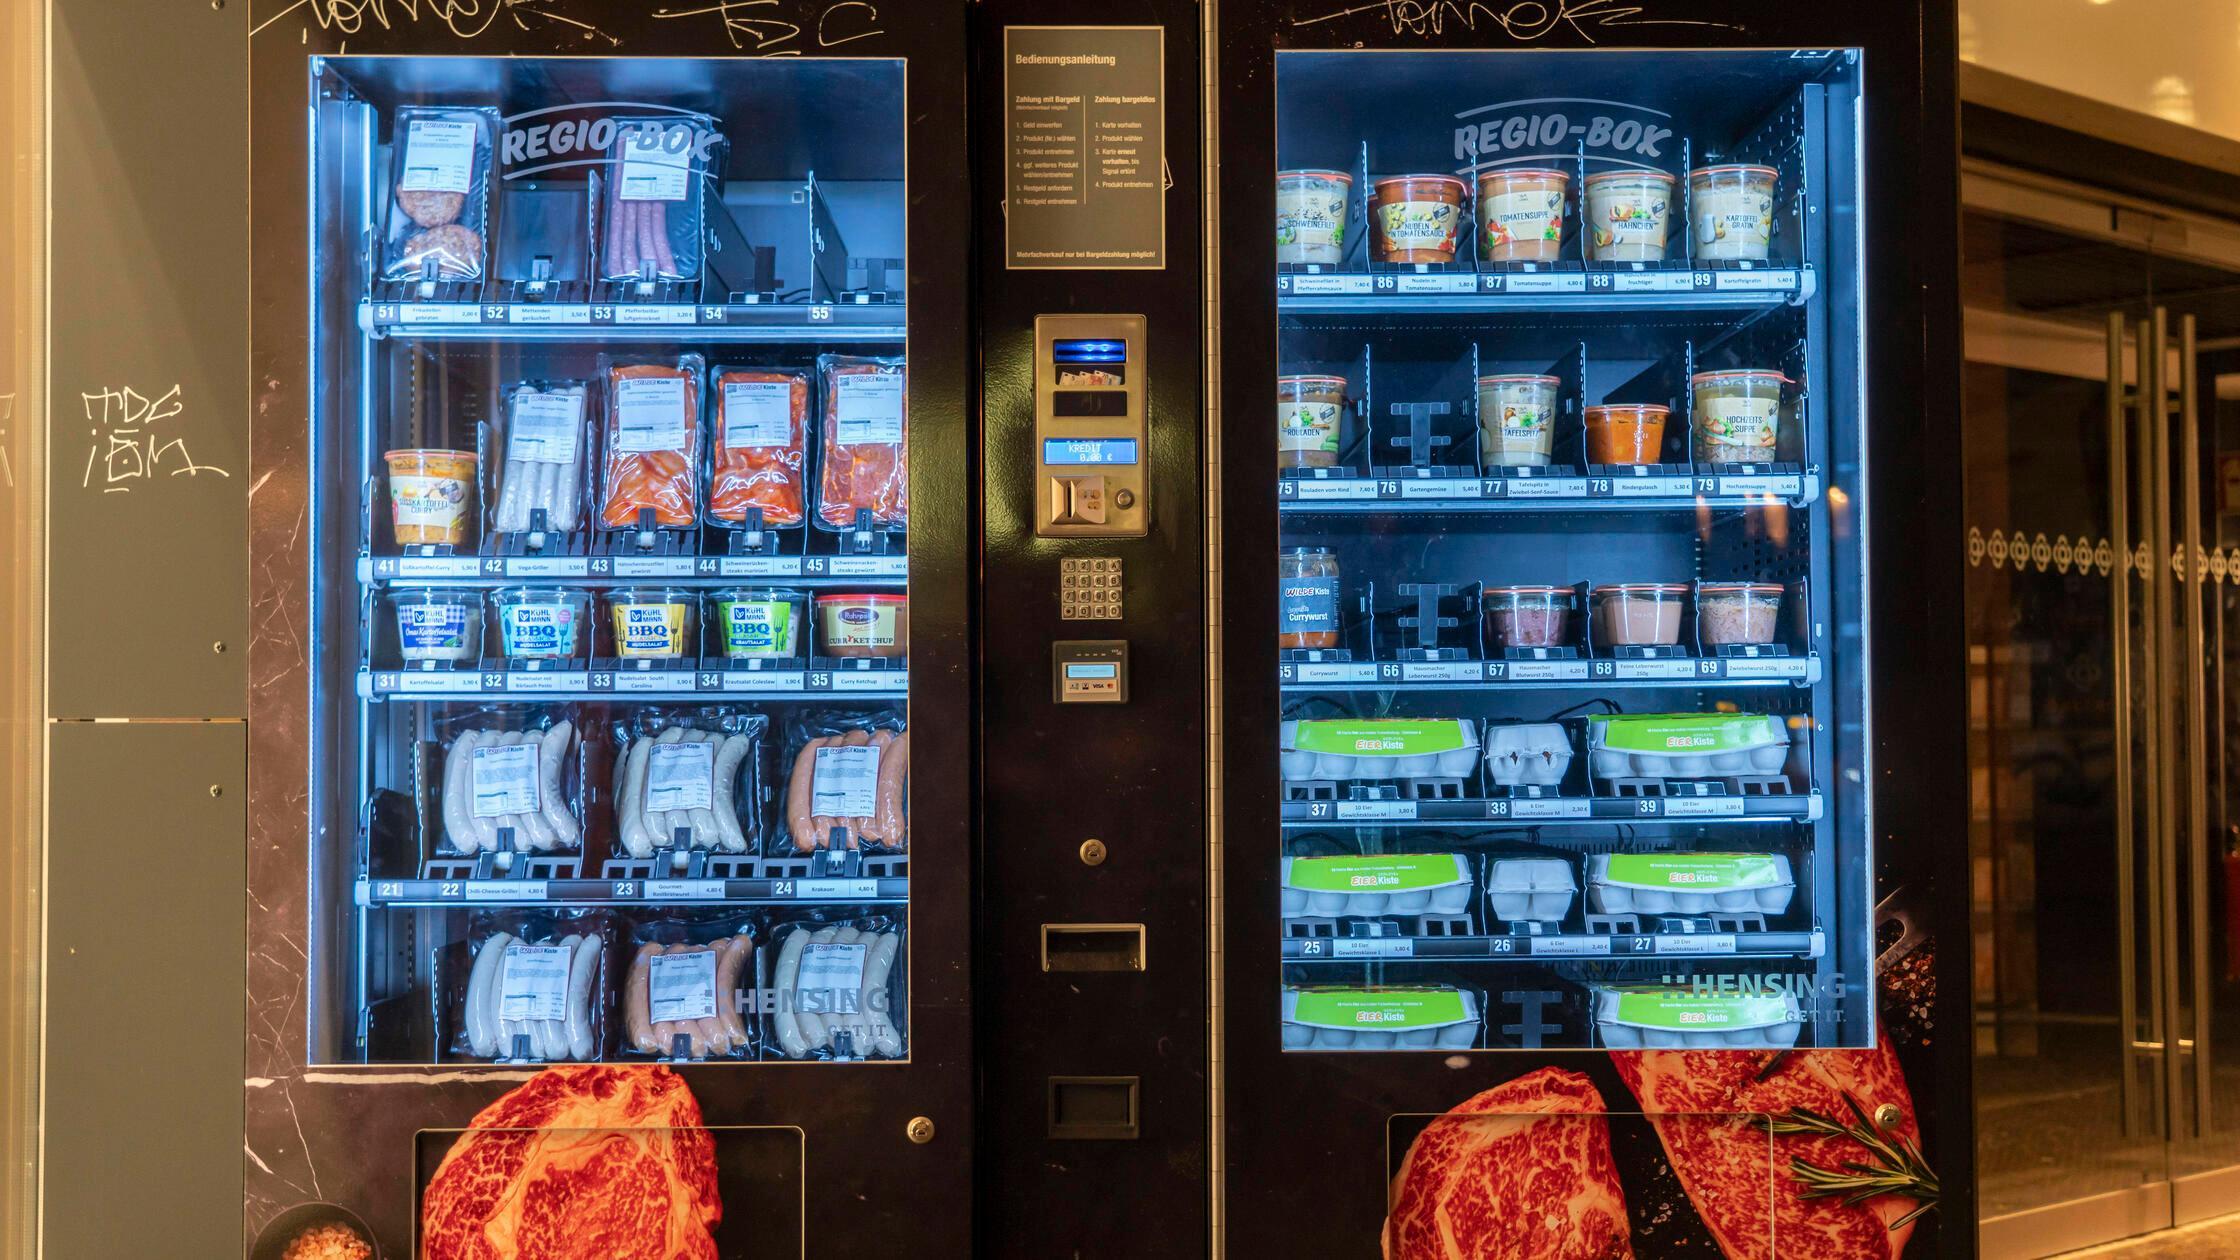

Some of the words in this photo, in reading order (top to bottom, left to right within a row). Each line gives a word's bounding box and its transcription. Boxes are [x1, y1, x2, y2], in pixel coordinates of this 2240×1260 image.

[1016, 54, 1116, 66] Bedienungsanleitung
[1016, 96, 1042, 104] Zahlung
[1055, 96, 1080, 104] Bargeld
[1094, 96, 1120, 104] Zahlung
[1122, 96, 1156, 104] bargeldlos
[502, 118, 723, 165] REGIO-BOX
[1454, 114, 1672, 160] REGIO-BOX
[1500, 211, 1549, 222] TOMATENSUPPE
[1377, 276, 1394, 289] 86
[1486, 276, 1502, 288] 87
[1592, 275, 1608, 287] 88
[1694, 273, 1710, 286] 89
[379, 306, 394, 318] 51
[487, 306, 504, 318] 52
[595, 307, 612, 318] 53
[706, 308, 722, 320] 54
[812, 308, 828, 319] 55
[1288, 428, 1320, 436] ROULADEN
[1068, 444, 1100, 453] KREDIT
[1380, 482, 1396, 494] 76
[1486, 481, 1502, 493] 77
[1592, 480, 1608, 492] 78
[1698, 479, 1714, 491] 79
[379, 560, 395, 572] 41
[486, 560, 502, 572] 42
[592, 560, 608, 572] 43
[700, 560, 716, 571] 44
[807, 559, 824, 571] 45
[1285, 587, 1315, 598] WILDE
[1289, 613, 1328, 622] Currywurst
[515, 626, 556, 638] BBQ
[628, 625, 668, 637] BBQ
[732, 623, 770, 635] BBQ
[829, 635, 853, 644] CURRY
[1383, 664, 1399, 677] 66
[1489, 664, 1504, 676] 67
[1596, 662, 1612, 674] 68
[1701, 661, 1717, 674] 69
[380, 674, 395, 687] 31
[485, 674, 502, 686] 32
[594, 674, 610, 686] 33
[702, 674, 718, 686] 34
[812, 674, 828, 686] 35
[1355, 739, 1383, 750] EIER
[1383, 740, 1404, 750] Kiste
[1666, 736, 1693, 748] EIER
[1694, 737, 1714, 745] Kiste
[1311, 804, 1327, 816] 37
[1491, 802, 1507, 814] 38
[1640, 800, 1656, 812] 39
[1351, 875, 1378, 886] EIER
[1378, 875, 1399, 885] Kiste
[1669, 872, 1696, 883] EIER
[1696, 873, 1718, 882] Kiste
[382, 883, 399, 896] 21
[442, 883, 458, 896] 22
[616, 882, 633, 895] 23
[776, 882, 792, 894] 24
[1304, 942, 1320, 954] 25
[1494, 939, 1510, 952] 26
[1635, 938, 1651, 950] 27
[1693, 973, 1846, 998] HENSING
[735, 988, 889, 1013] HENSING
[1356, 1010, 1384, 1022] EIER
[1384, 1012, 1405, 1021] Kiste
[1679, 1012, 1707, 1024] EIER
[1707, 1013, 1728, 1023] Kiste
[1784, 1010, 1820, 1023] GET
